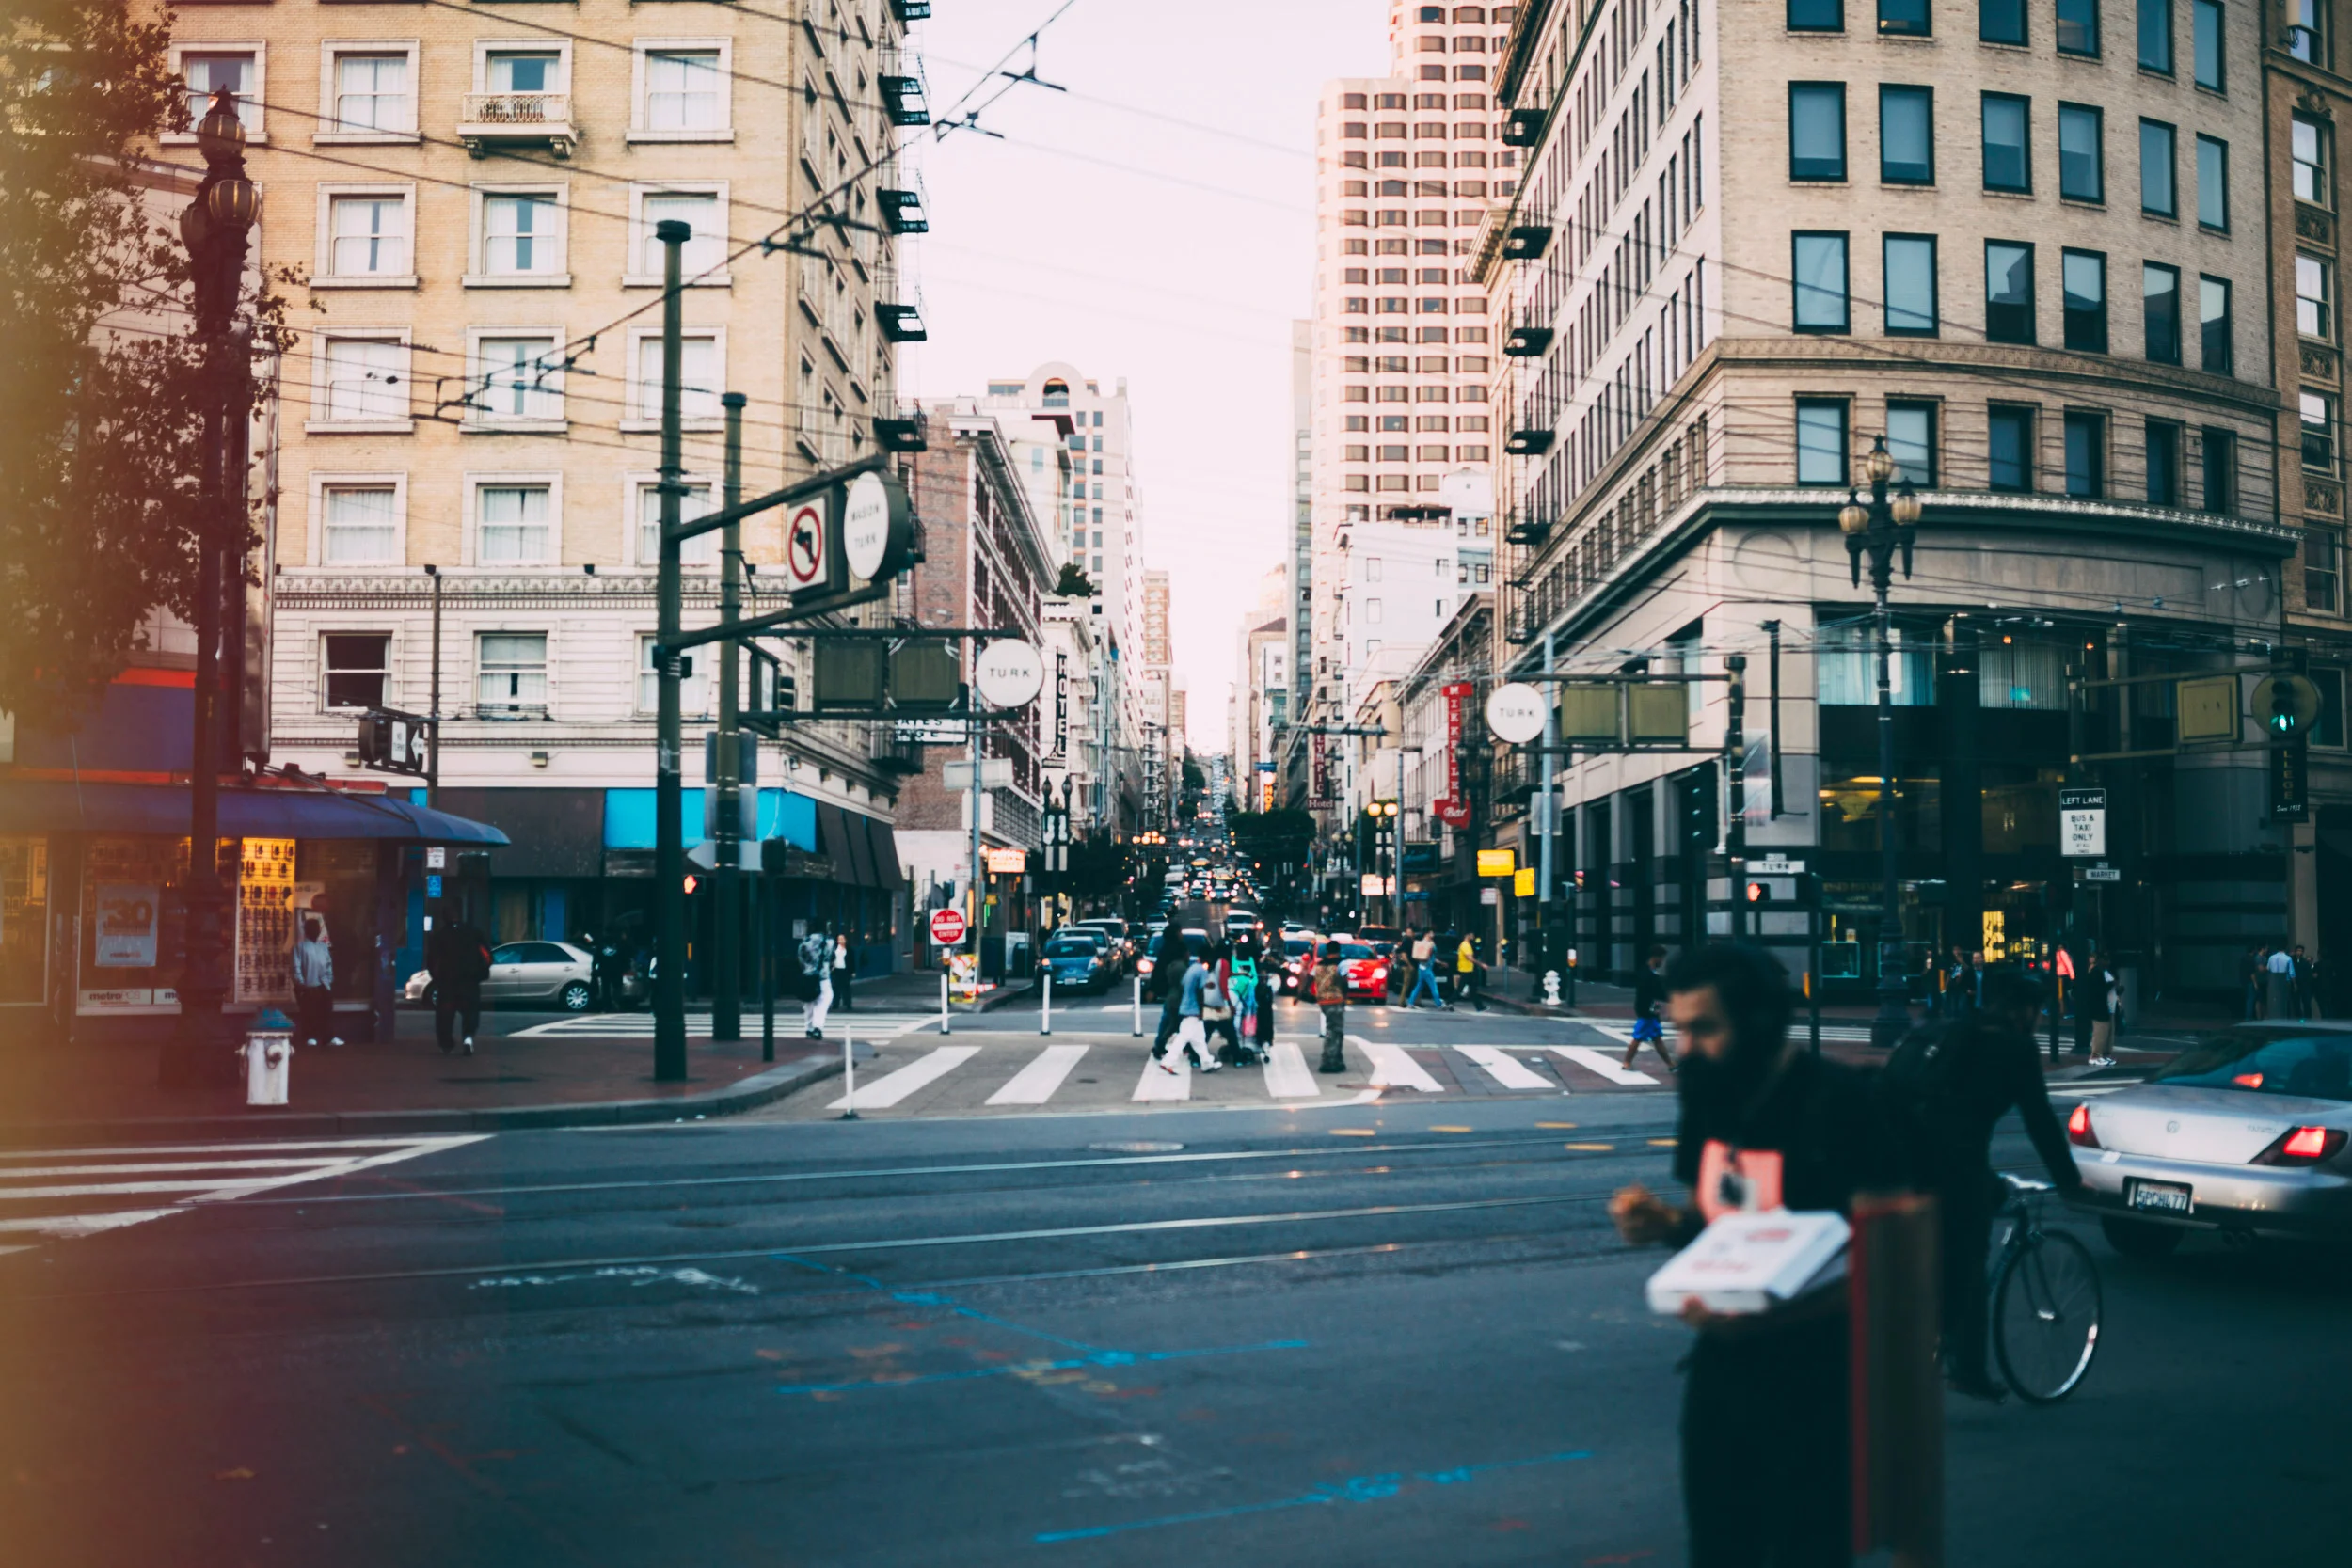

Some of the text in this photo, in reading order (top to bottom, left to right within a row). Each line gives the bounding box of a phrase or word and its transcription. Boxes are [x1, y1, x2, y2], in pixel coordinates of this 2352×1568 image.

[854, 532, 876, 549] TURK
[990, 667, 1031, 678] TURK
[1500, 707, 1535, 718] TURK
[1309, 800, 1334, 809] Hotel
[2062, 796, 2104, 805] LEFT LANE
[1443, 806, 1468, 818] Bar
[2071, 815, 2086, 823] BUS
[2090, 871, 2117, 879] MARKET
